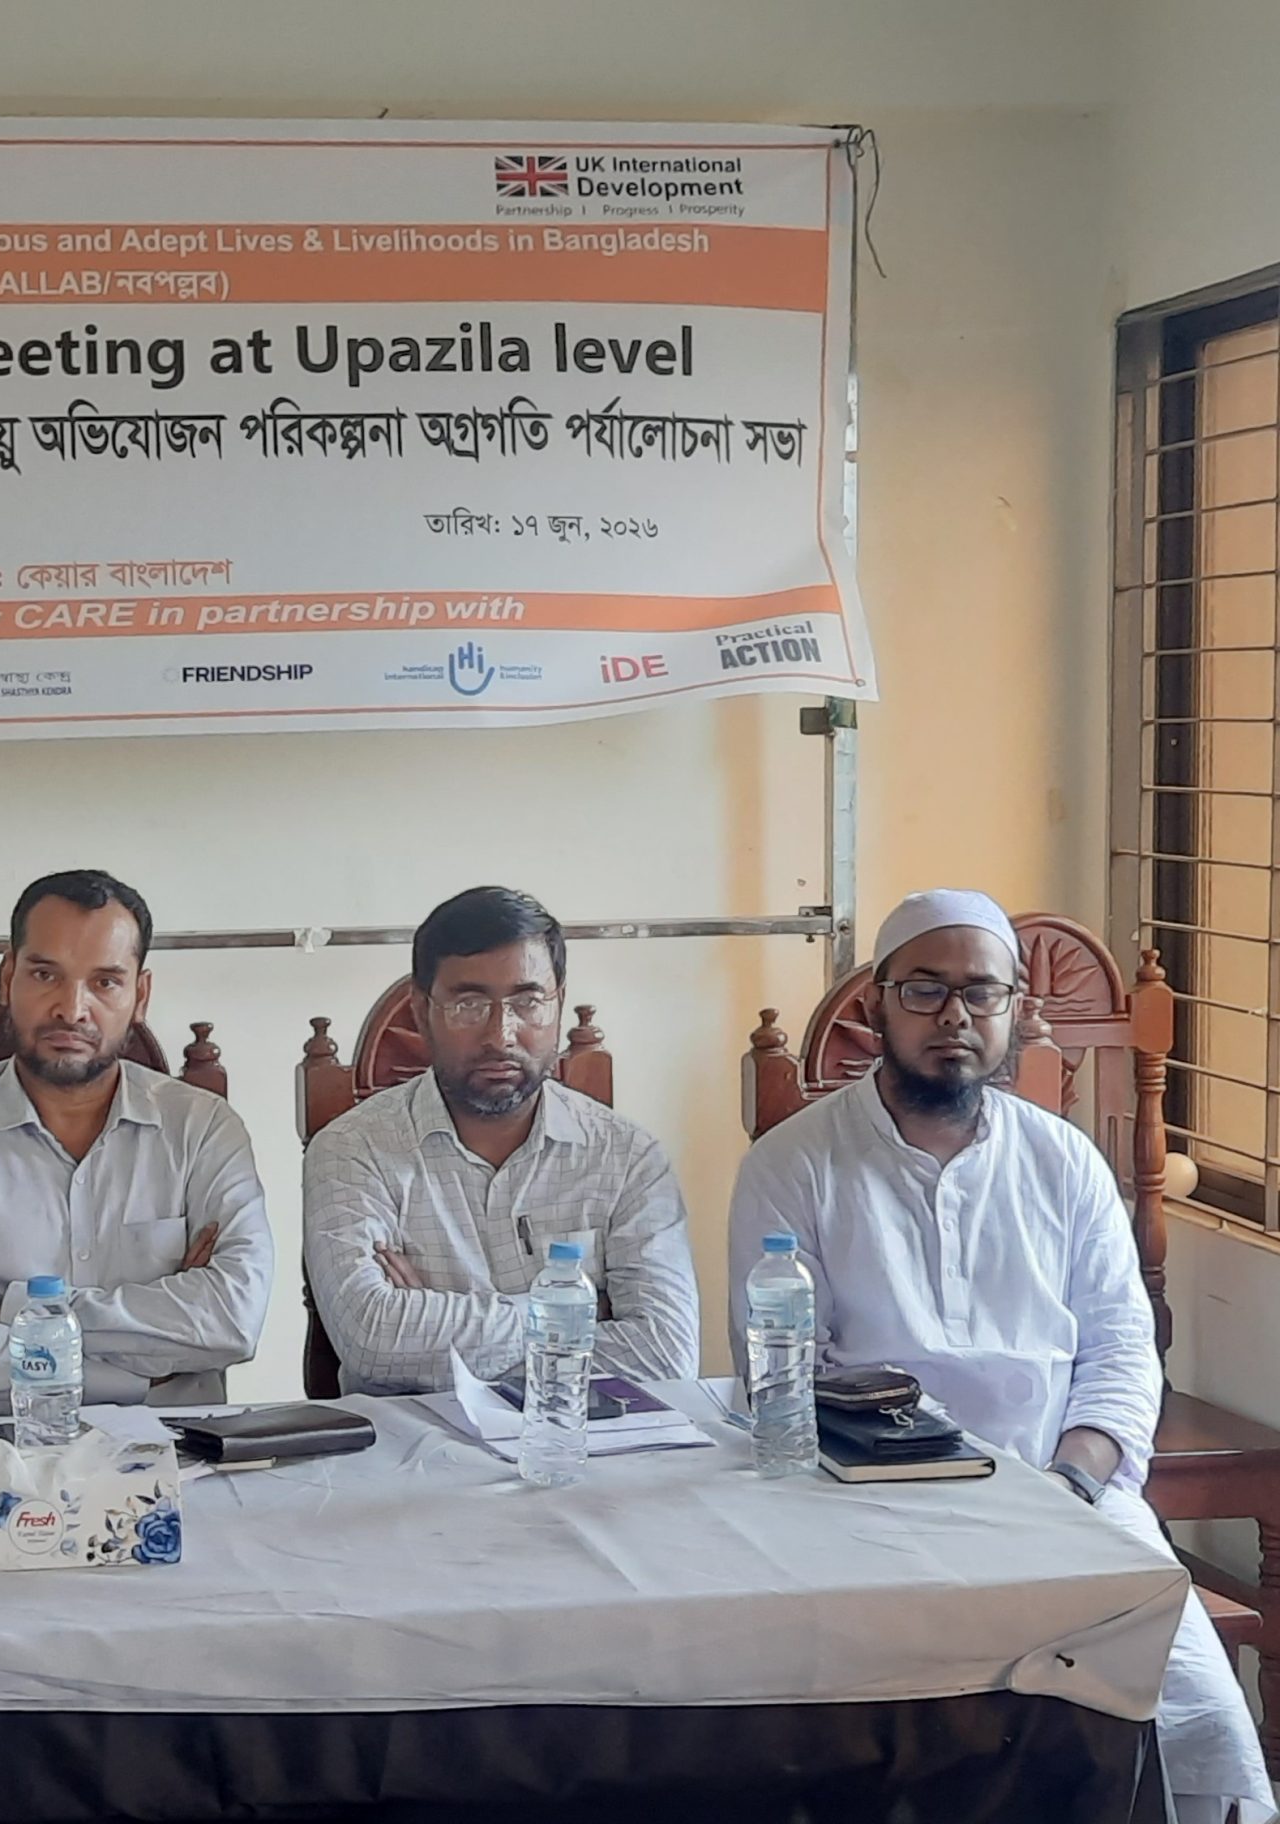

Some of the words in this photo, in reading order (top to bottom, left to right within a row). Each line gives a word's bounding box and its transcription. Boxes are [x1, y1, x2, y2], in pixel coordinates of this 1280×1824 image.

[575, 156, 605, 173] UK
[612, 156, 742, 173] International
[577, 176, 743, 202] Development
[495, 203, 574, 218] Partnership
[602, 203, 659, 218] Progress
[678, 202, 745, 218] Prosperity
[57, 228, 111, 252] and
[120, 228, 209, 258] Adept
[216, 228, 294, 252] Lives
[303, 228, 324, 252] &
[333, 228, 500, 252] Livelihoods
[508, 228, 534, 252] in
[543, 227, 709, 257] Bangladesh
[210, 329, 273, 375] at
[296, 321, 530, 388] Upazila
[554, 322, 693, 377] level
[28, 398, 228, 461] অভিযোজন
[239, 396, 408, 460] পরিকল্পনা
[415, 395, 553, 463] অগ্রগতি
[565, 396, 735, 462] পর্যালোচনা
[741, 419, 808, 465] সভা
[511, 515, 538, 537] ১৭
[547, 515, 590, 542] জুন,
[600, 517, 659, 539] ২০২৬
[16, 562, 100, 590] কেয়ার
[105, 558, 234, 588] বাংলাদেশ
[14, 603, 134, 628] CARE
[147, 601, 185, 626] in
[197, 596, 436, 630] partnership
[445, 595, 525, 621] with
[715, 621, 815, 646] Practical
[720, 637, 823, 671] ACTION
[182, 664, 313, 683] FRIENDSHIP
[600, 654, 670, 684] iDE
[16, 1511, 56, 1528] Fresh
